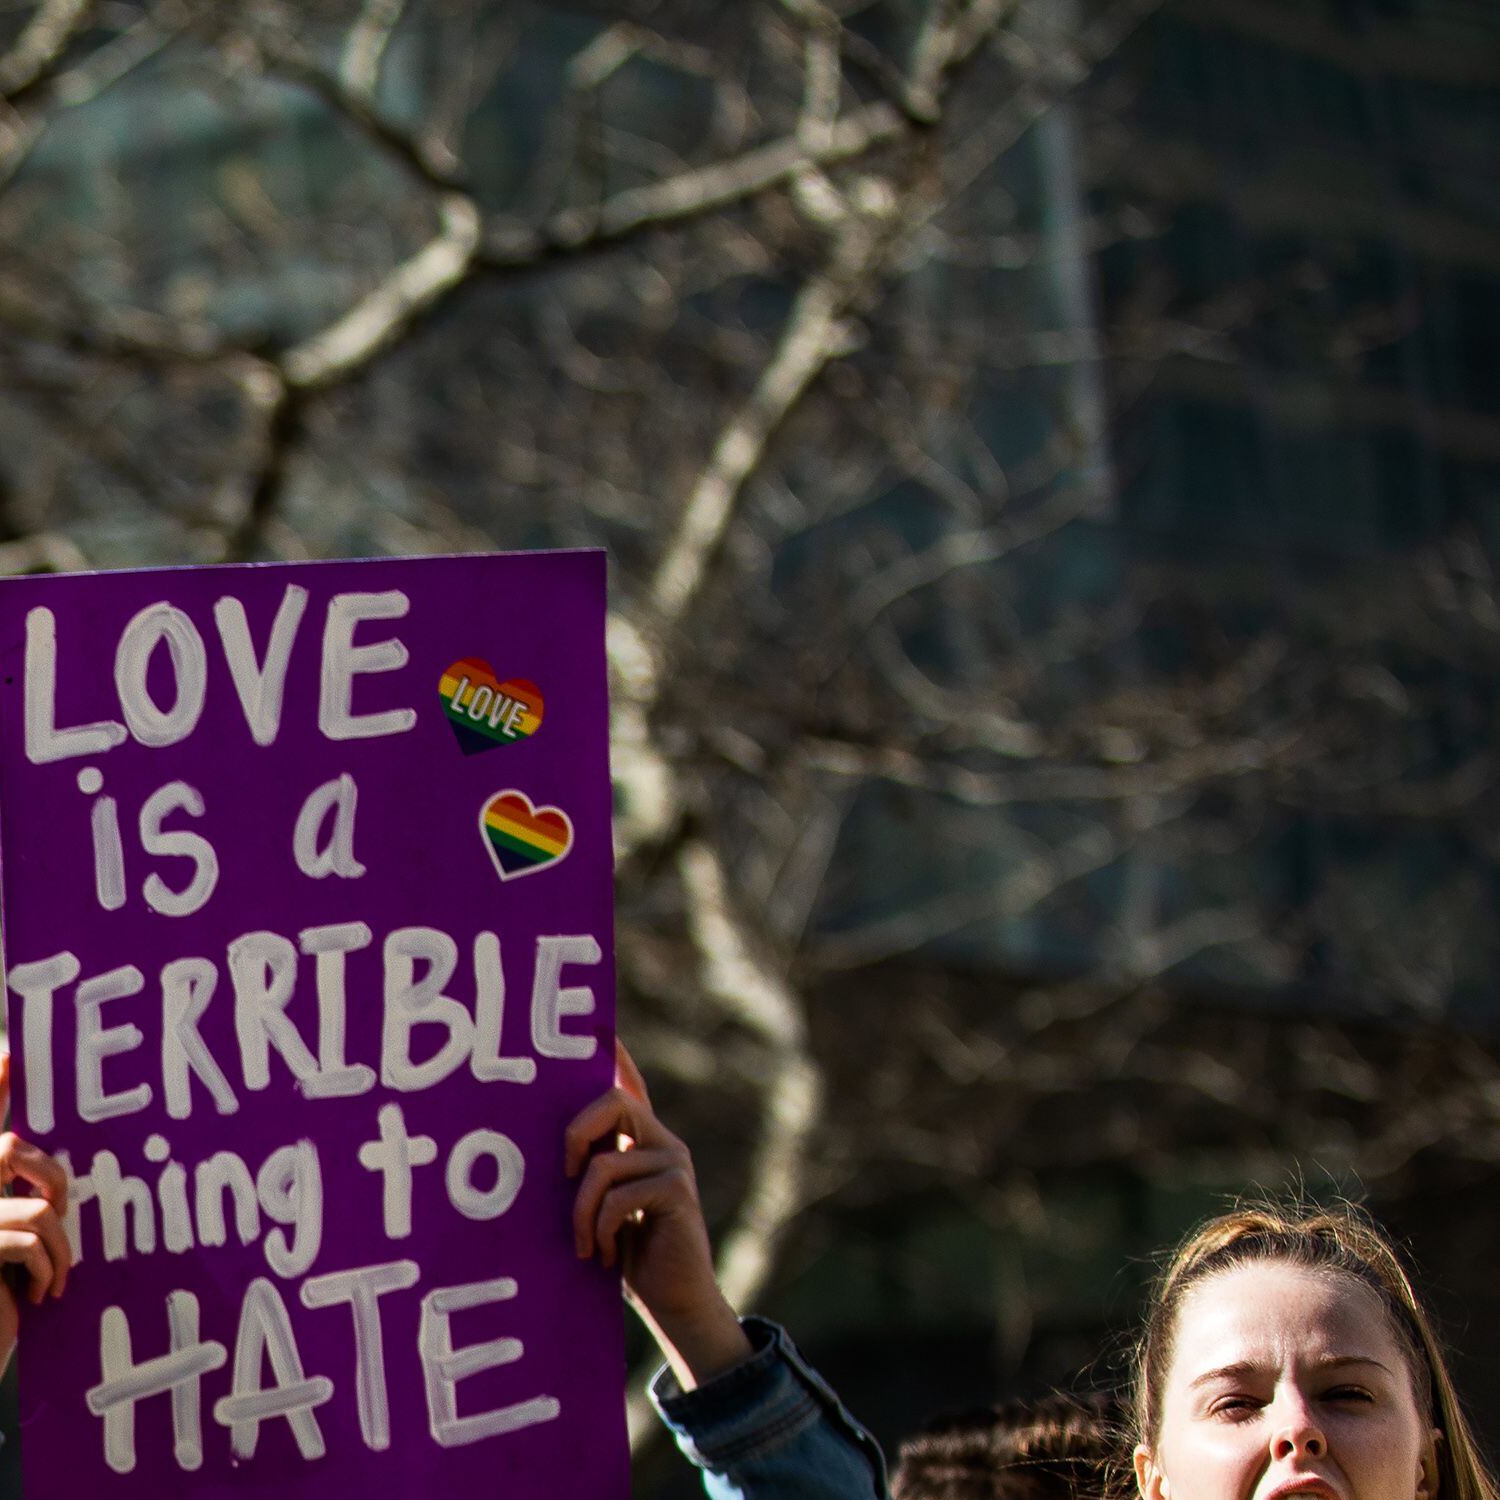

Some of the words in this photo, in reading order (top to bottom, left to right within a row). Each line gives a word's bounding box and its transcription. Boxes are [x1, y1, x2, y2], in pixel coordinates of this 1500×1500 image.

[24, 584, 417, 764] LOVE
[450, 676, 530, 739] LOVE
[77, 766, 219, 917] is
[293, 772, 368, 879] a
[8, 920, 602, 1134] TERRIBLE
[52, 1133, 323, 1279] thing
[358, 1101, 525, 1240] to
[85, 1259, 561, 1473] HATE
